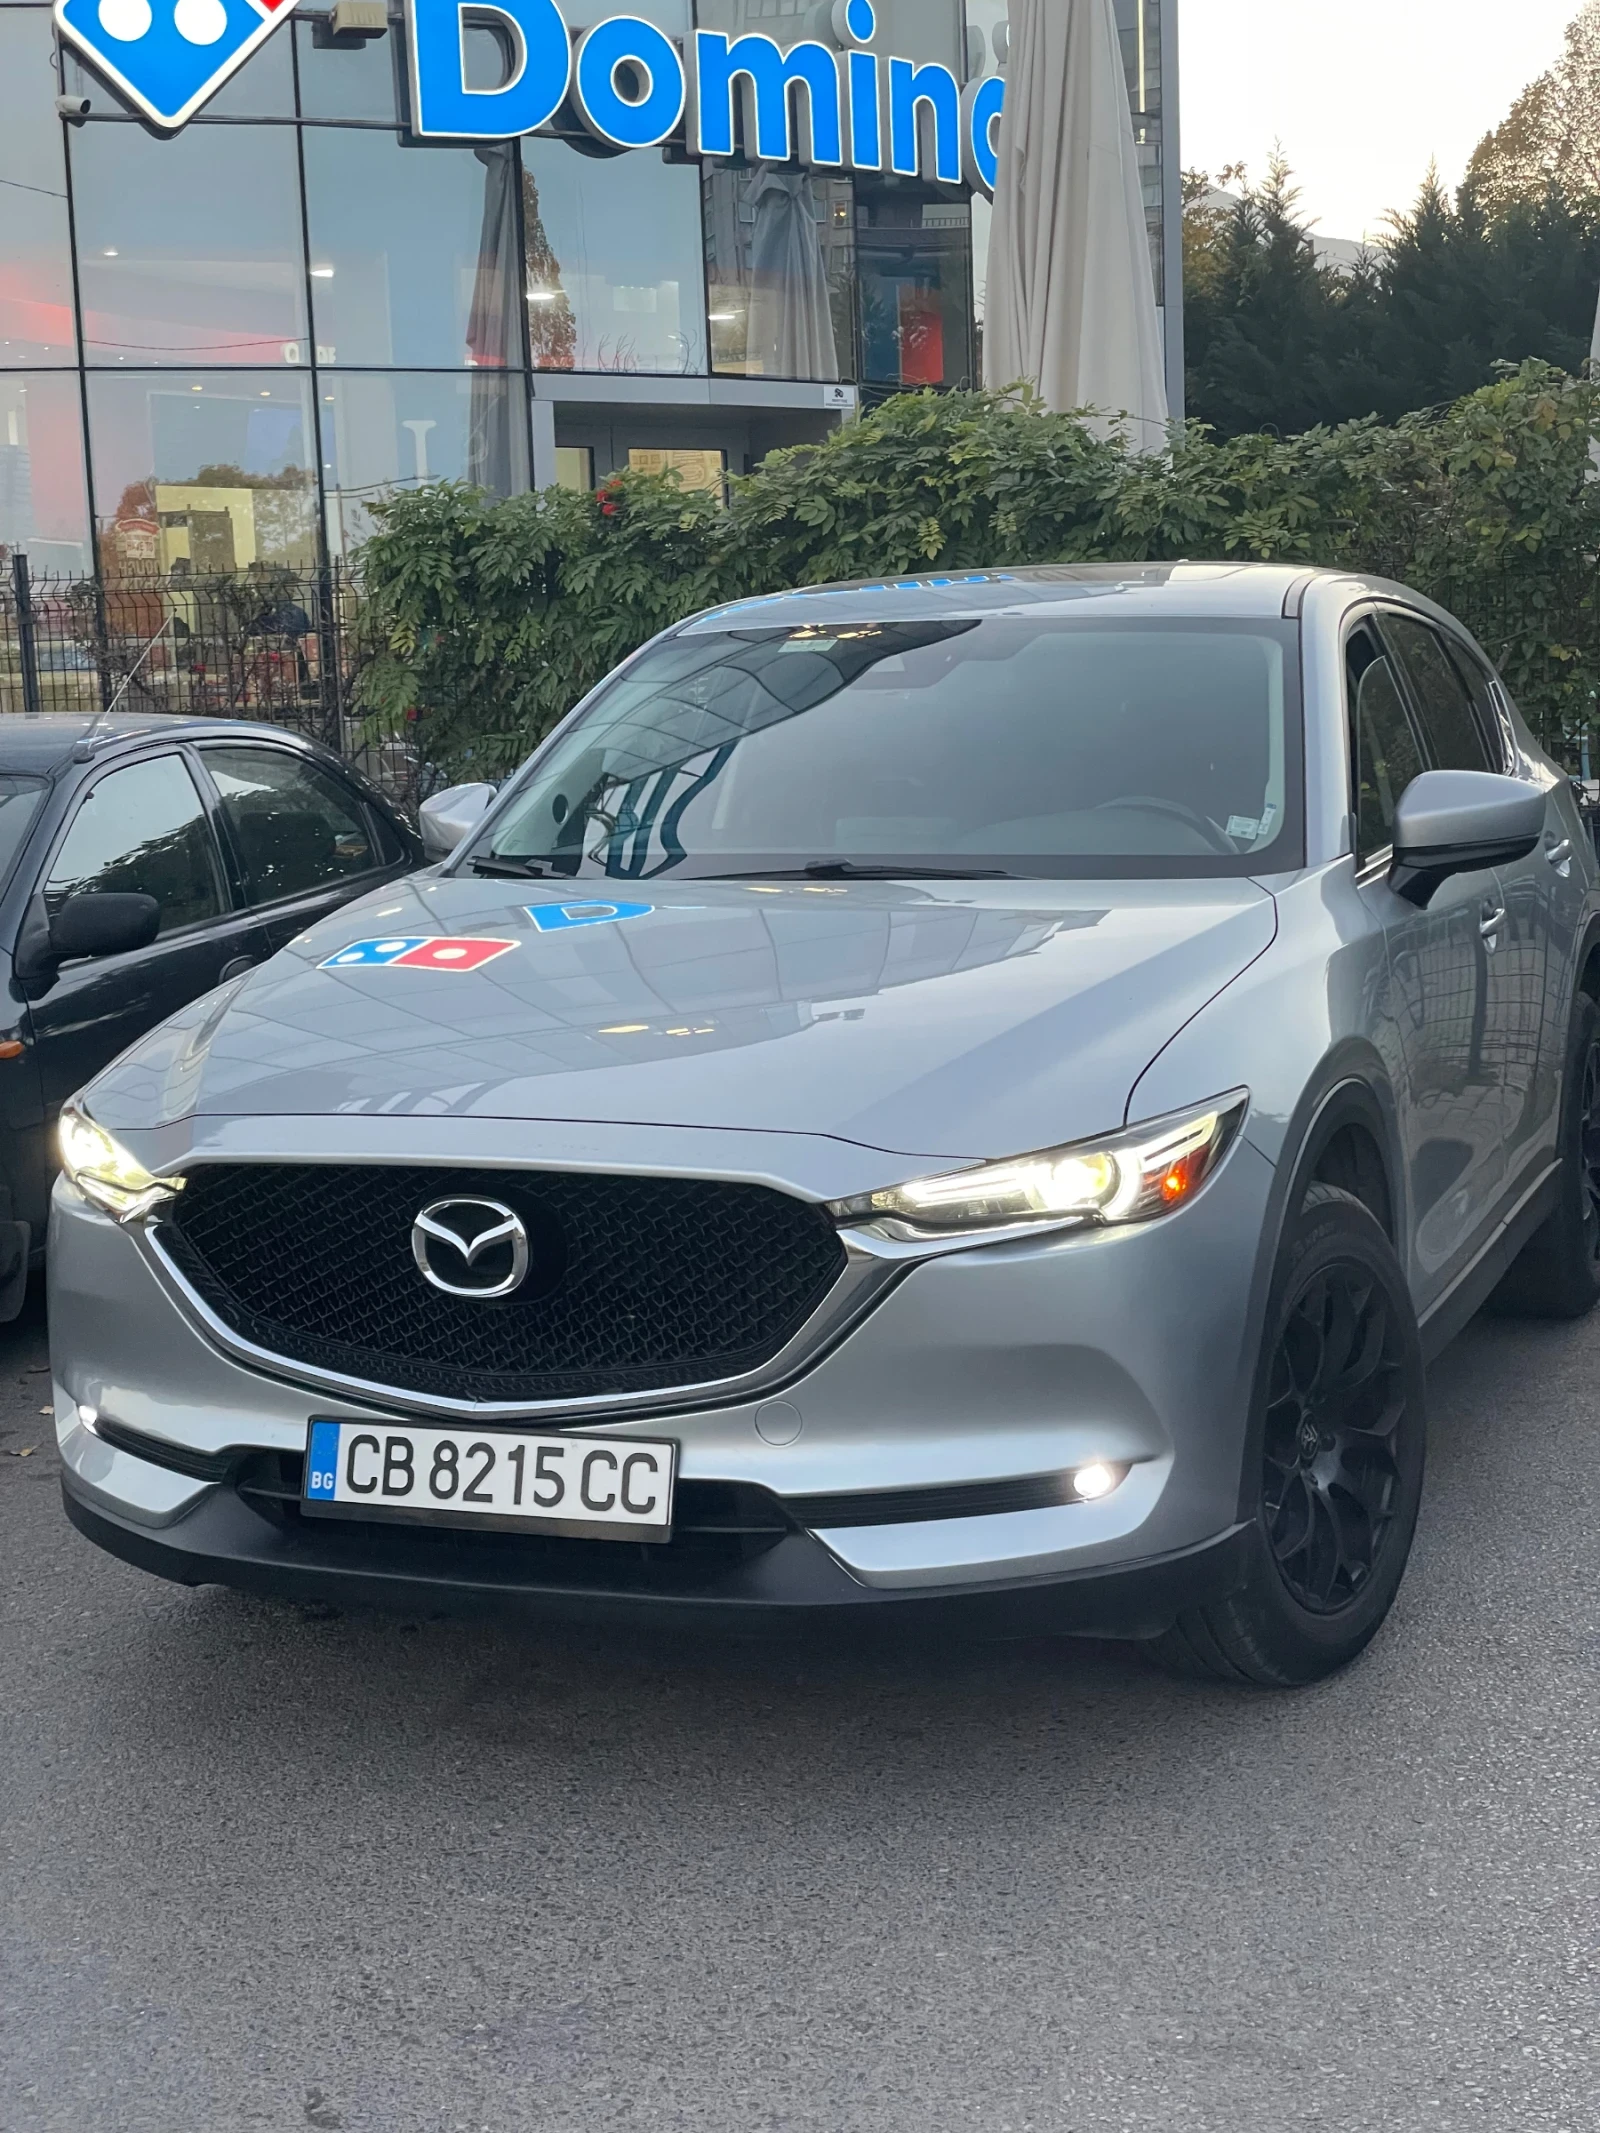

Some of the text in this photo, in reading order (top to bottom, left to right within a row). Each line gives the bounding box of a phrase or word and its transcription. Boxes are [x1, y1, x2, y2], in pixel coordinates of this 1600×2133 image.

[311, 1471, 334, 1490] BG
[346, 1434, 659, 1515] CB 8215 CC
